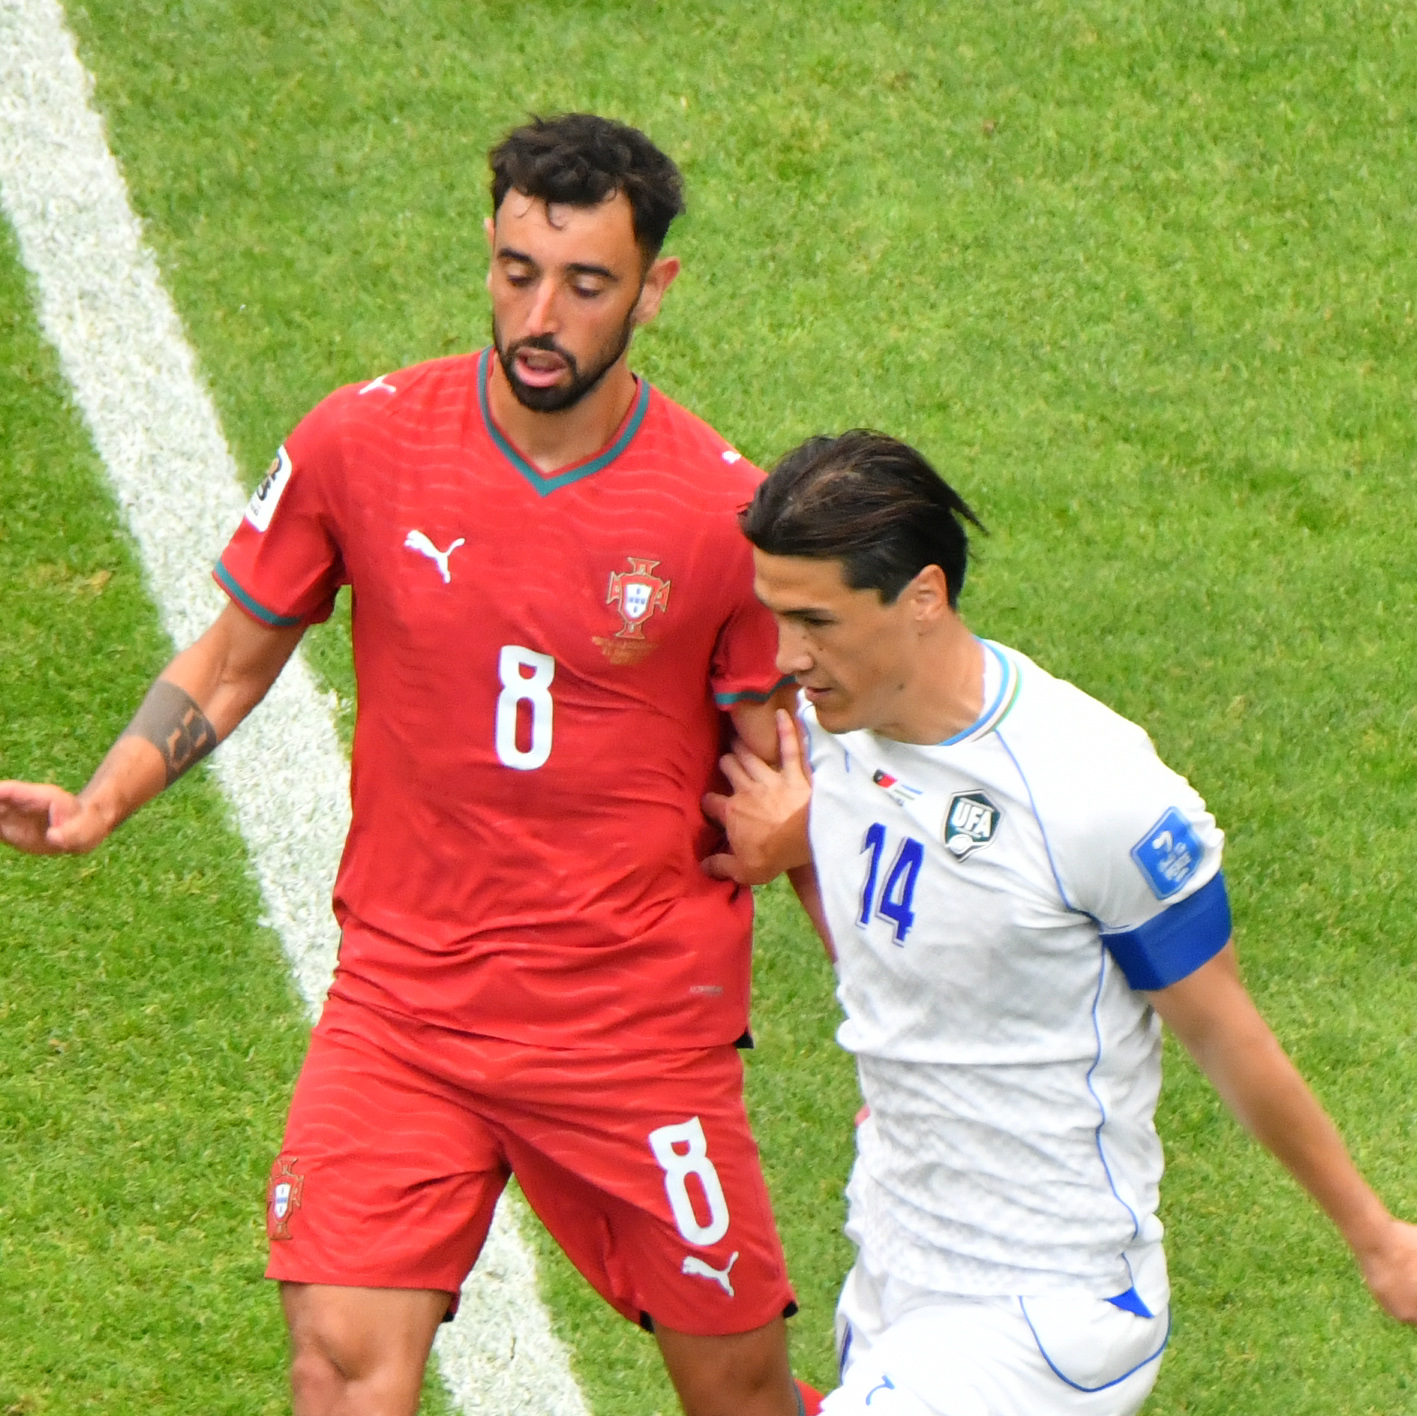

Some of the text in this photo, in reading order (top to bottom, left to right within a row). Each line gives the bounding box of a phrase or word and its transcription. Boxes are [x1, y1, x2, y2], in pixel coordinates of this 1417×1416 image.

[495, 644, 555, 771] 8
[950, 799, 994, 838] UFA
[855, 821, 926, 947] 14
[648, 1116, 730, 1247] 8
